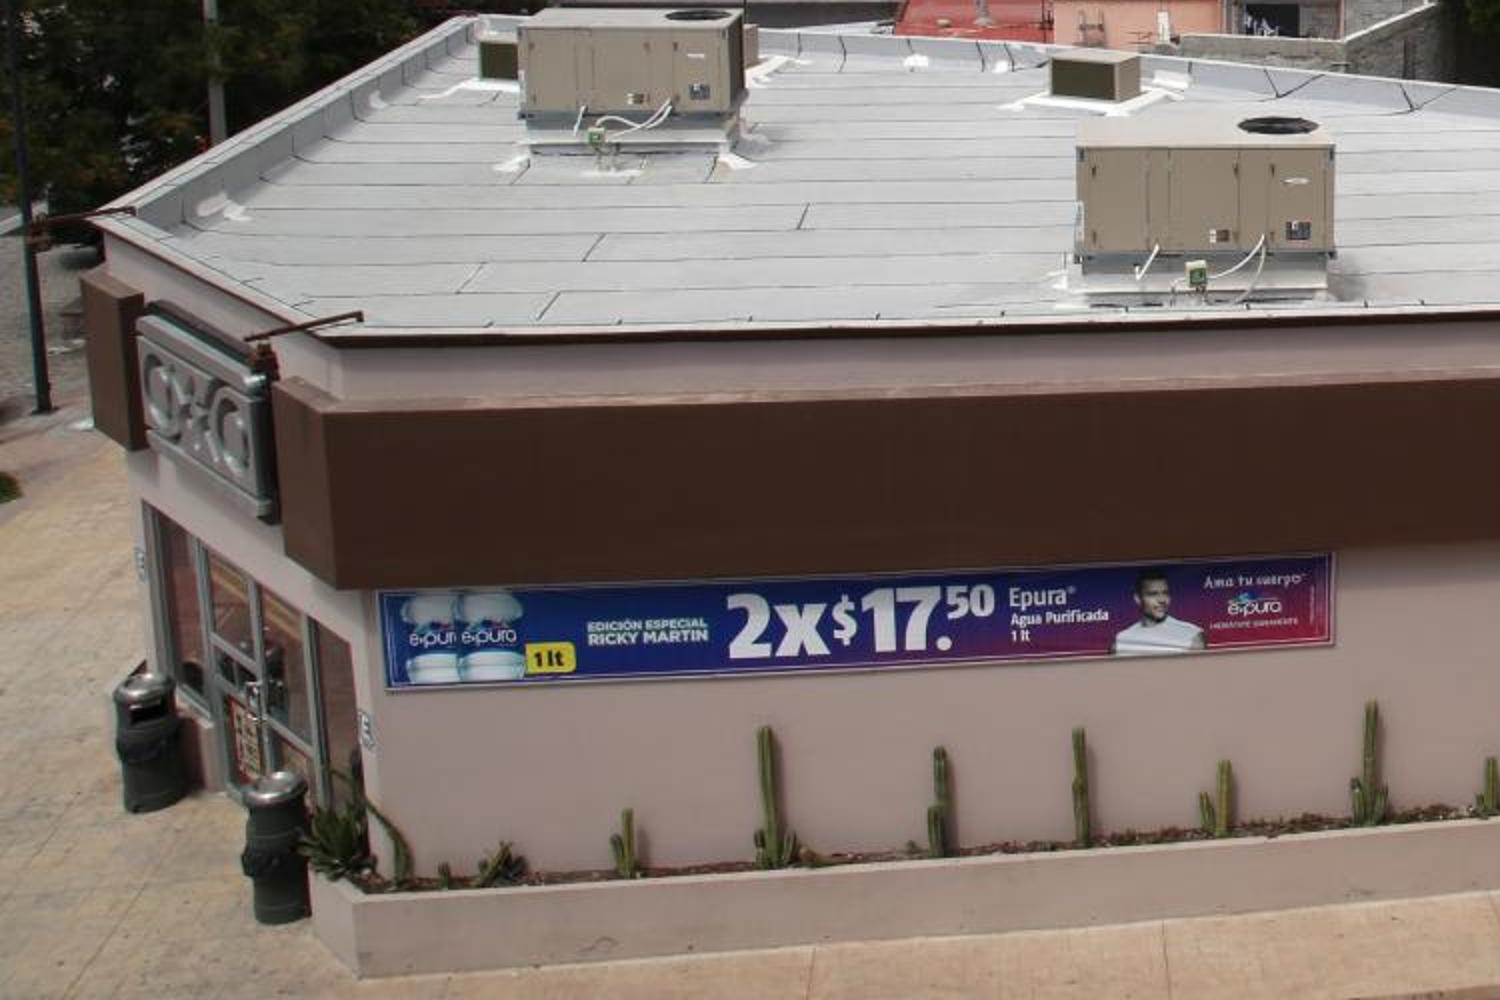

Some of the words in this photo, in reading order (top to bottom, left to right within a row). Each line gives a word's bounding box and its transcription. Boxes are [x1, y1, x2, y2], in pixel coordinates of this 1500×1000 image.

[142, 353, 250, 476] OXXO
[1009, 586, 1067, 611] Epura
[587, 619, 642, 632] EDICIÓN
[645, 617, 708, 630] ESPECIAL
[1011, 612, 1042, 628] Agua
[1045, 608, 1109, 624] Purificada
[588, 631, 638, 646] RICKY
[643, 629, 709, 643] MARTIN
